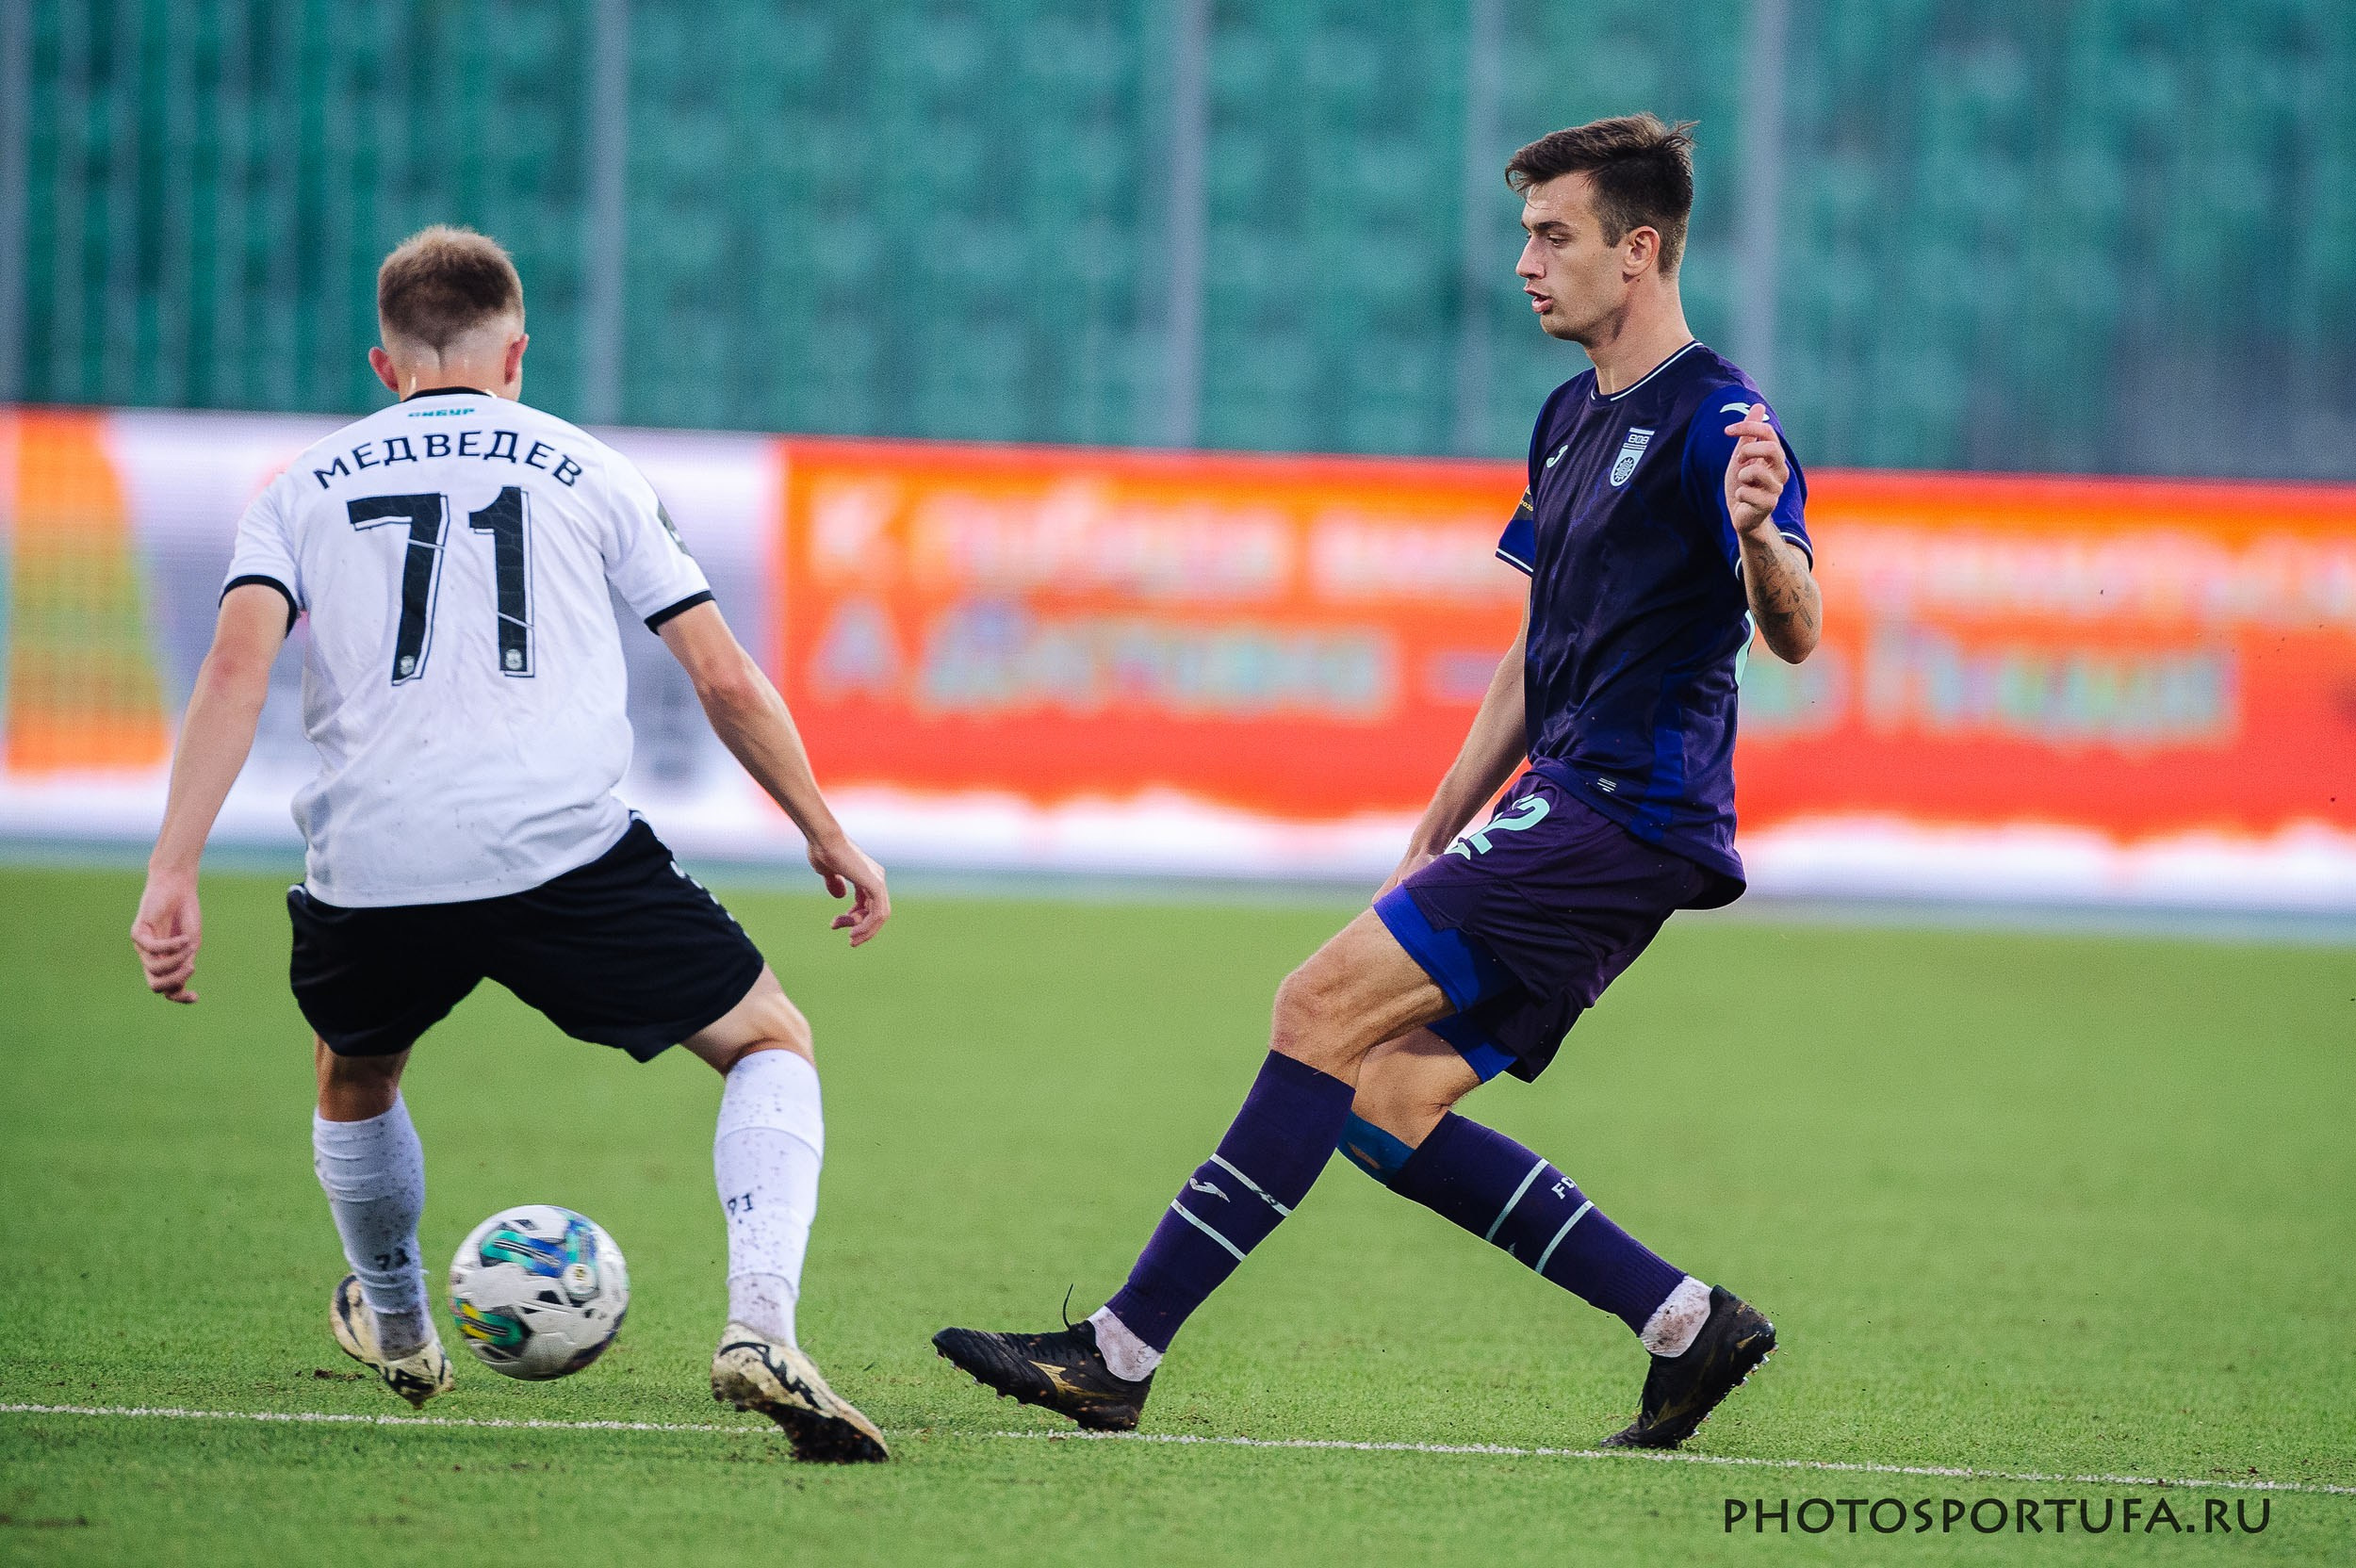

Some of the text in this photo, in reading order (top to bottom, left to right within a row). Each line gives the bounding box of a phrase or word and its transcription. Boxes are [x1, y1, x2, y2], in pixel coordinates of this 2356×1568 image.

[313, 430, 583, 490] МЕДВЕДЕВ
[346, 485, 536, 687] 71
[1444, 794, 1550, 860] 2
